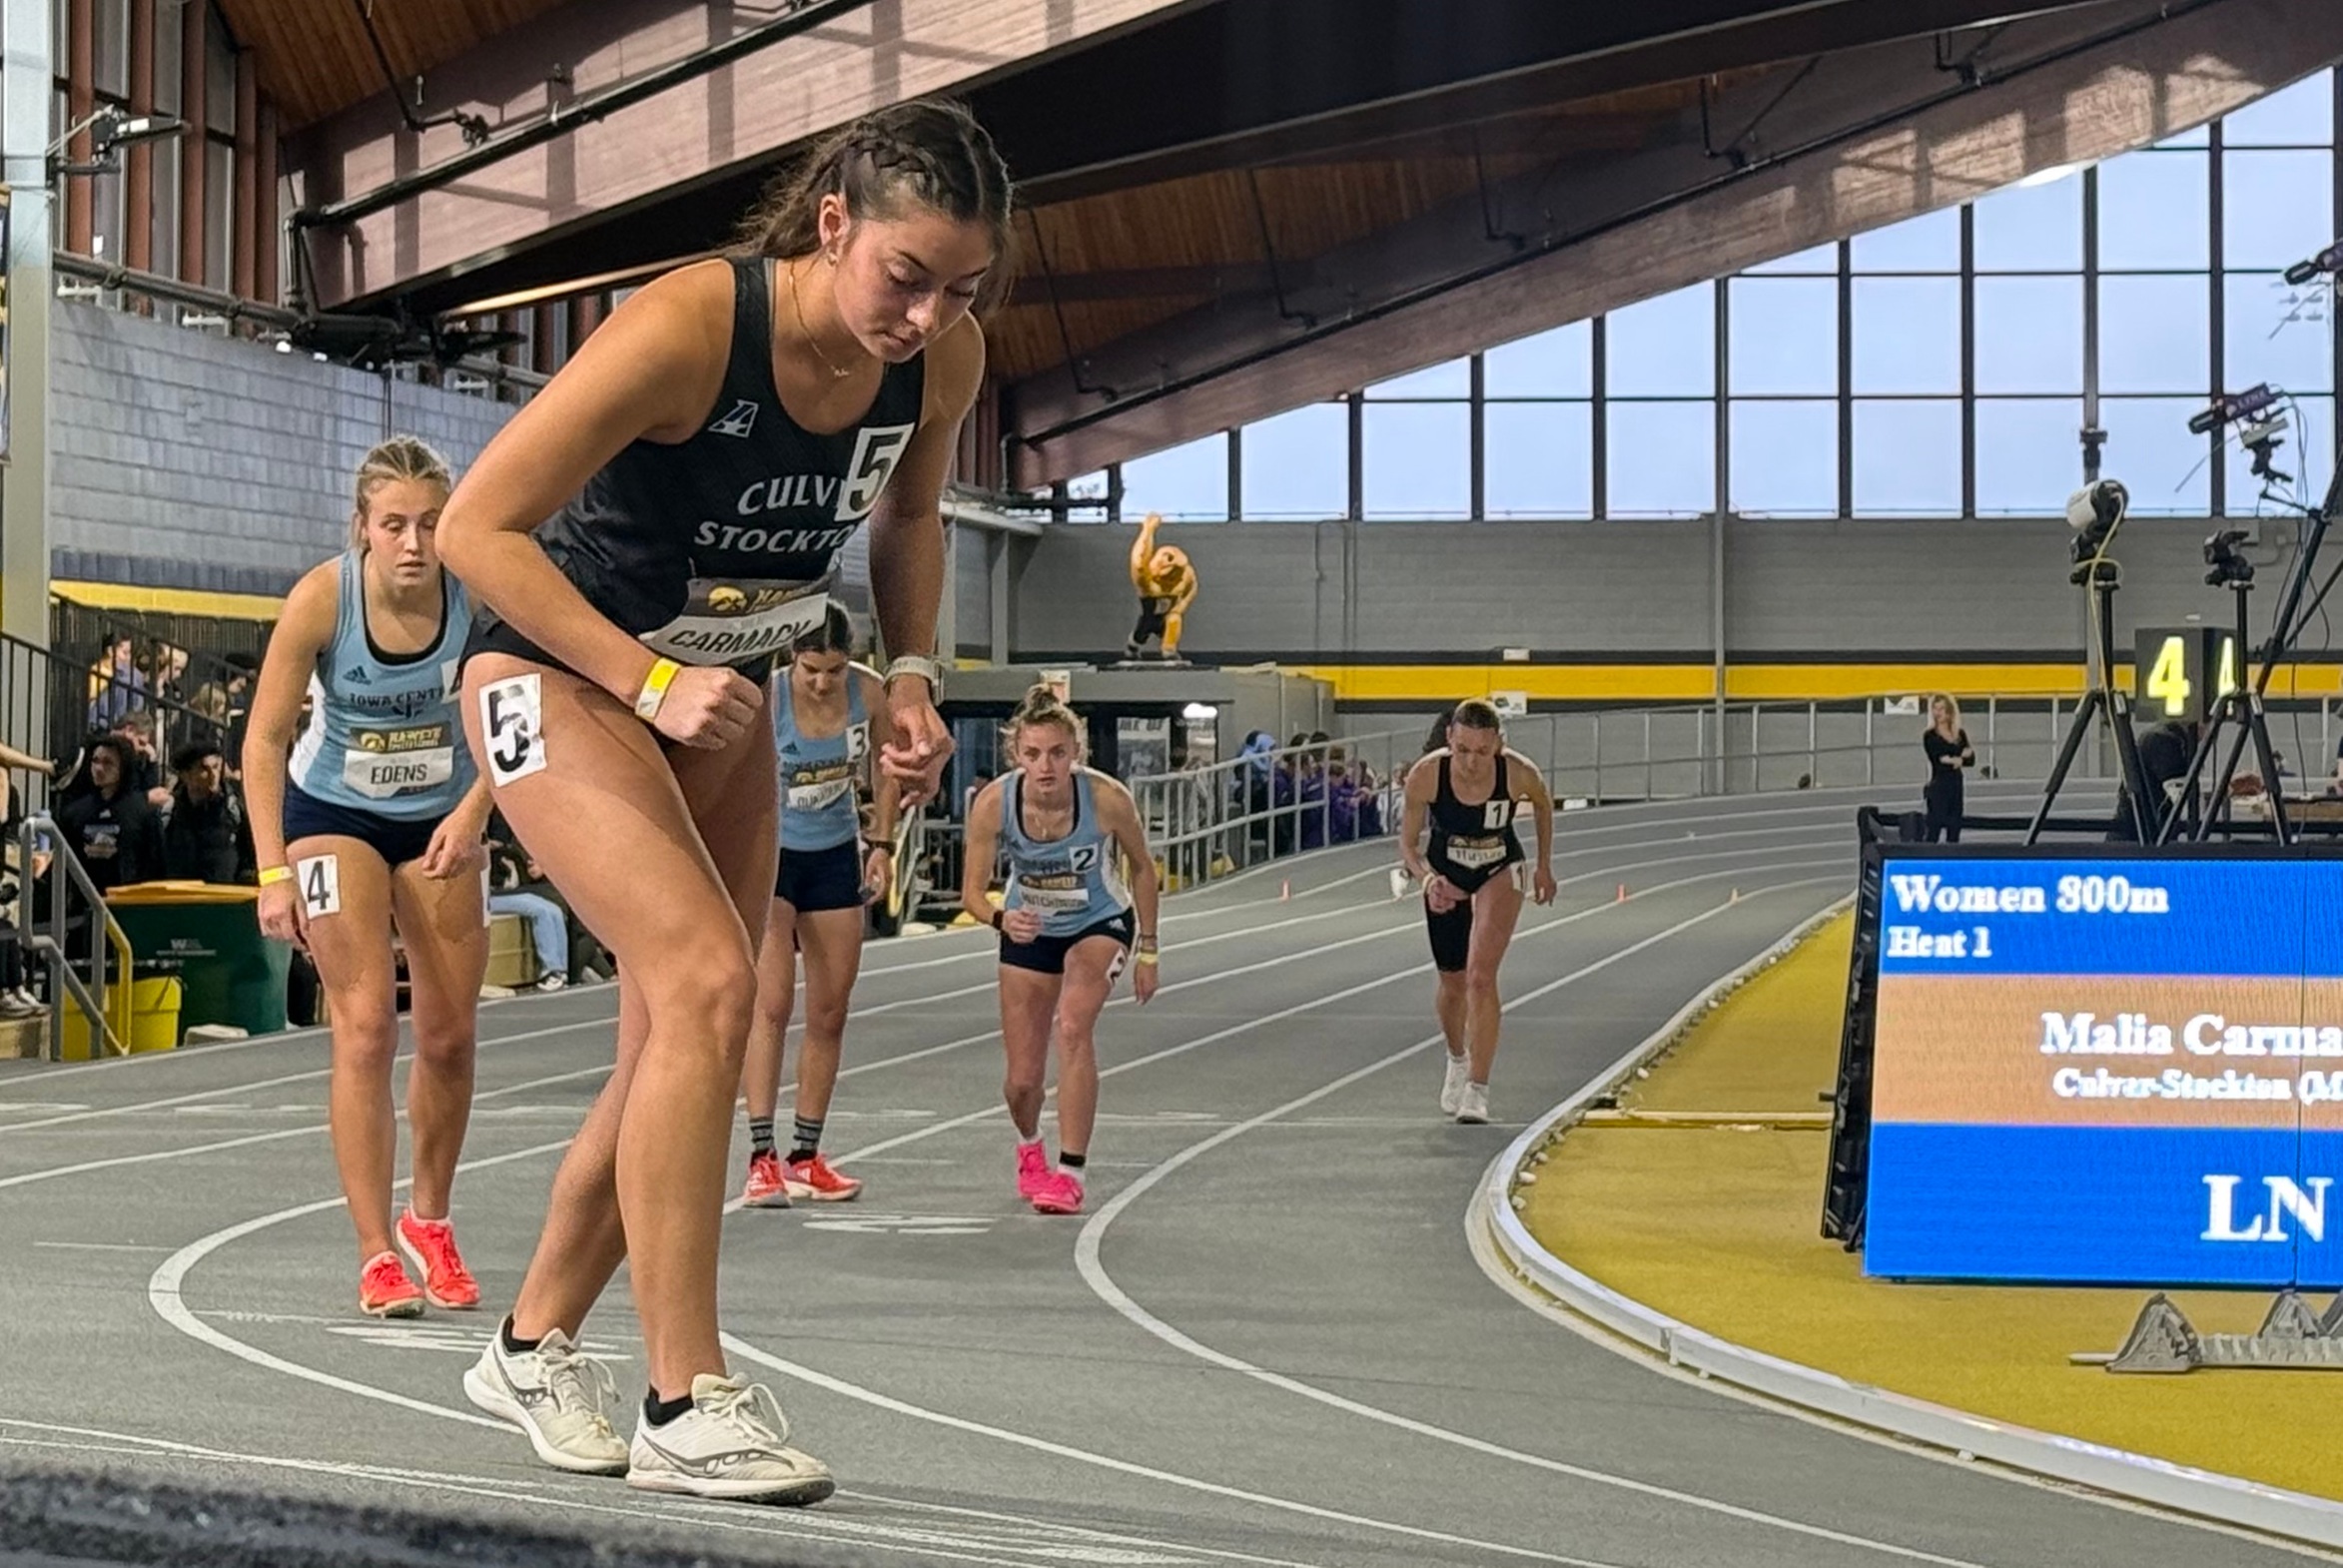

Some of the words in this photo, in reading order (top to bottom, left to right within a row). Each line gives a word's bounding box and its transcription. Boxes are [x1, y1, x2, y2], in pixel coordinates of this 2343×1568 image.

[849, 431, 905, 512] 5
[2147, 636, 2190, 716] 4
[350, 692, 392, 707] IOWA
[488, 684, 530, 773] 5
[852, 726, 866, 759] 3
[370, 763, 428, 785] EDENS
[1493, 803, 1502, 827] 1
[1074, 848, 1096, 871] 2
[308, 861, 331, 910] 4
[1890, 874, 2047, 913] Women
[2055, 875, 2170, 914] 800m
[1887, 926, 1967, 958] Heat
[1971, 926, 1992, 958] 1
[2039, 1012, 2174, 1054] Malia
[2052, 1068, 2292, 1100] Culver-Stockton
[2200, 1175, 2334, 1242] LN
